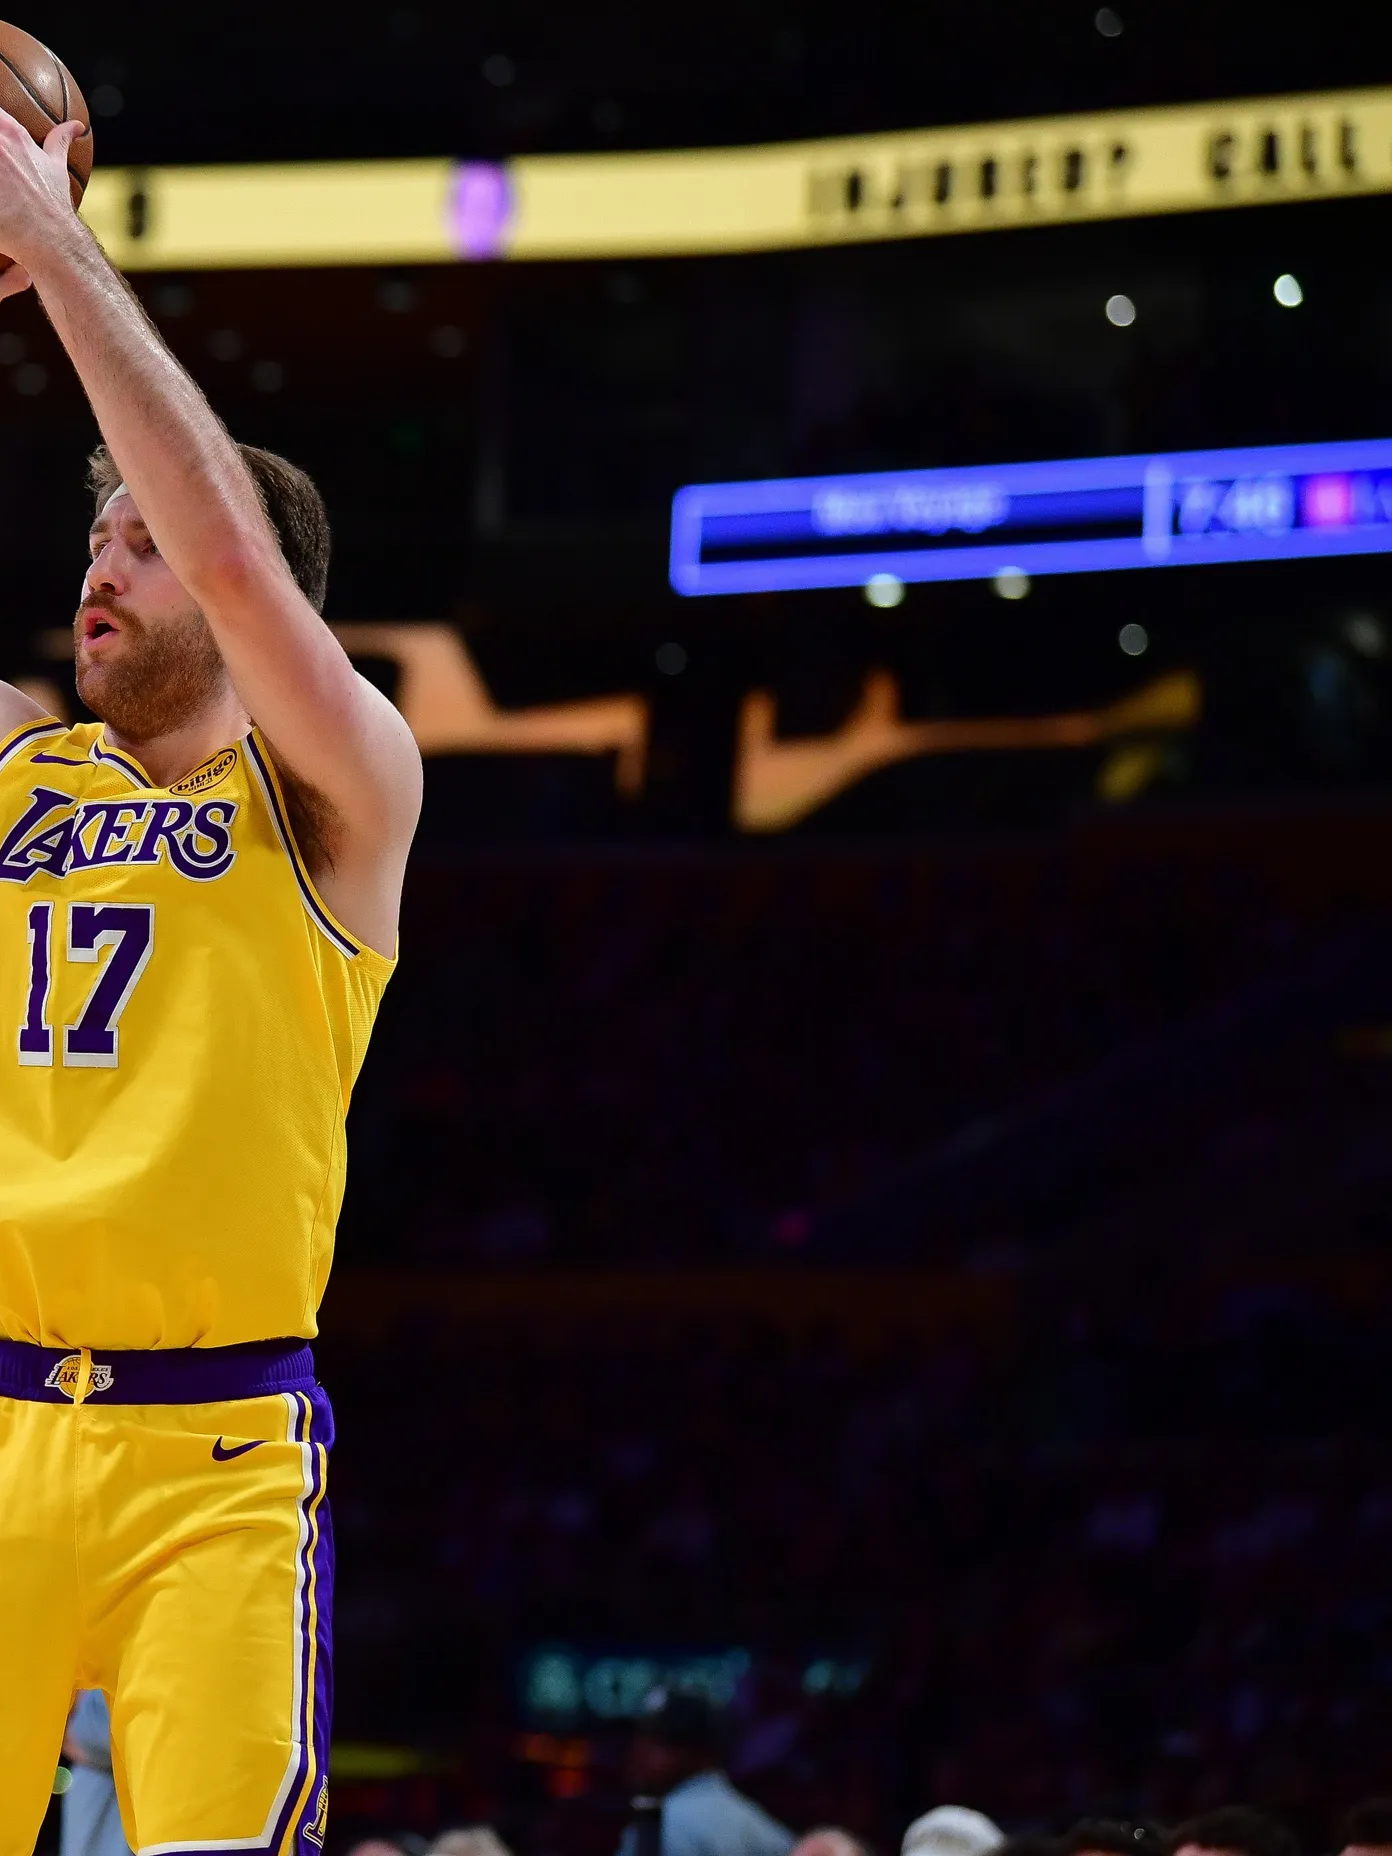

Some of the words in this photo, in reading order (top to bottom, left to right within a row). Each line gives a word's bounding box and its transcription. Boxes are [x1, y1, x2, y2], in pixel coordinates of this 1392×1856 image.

[177, 754, 234, 792] bibigo
[18, 901, 155, 1068] 17
[45, 1364, 115, 1391] LAKRS
